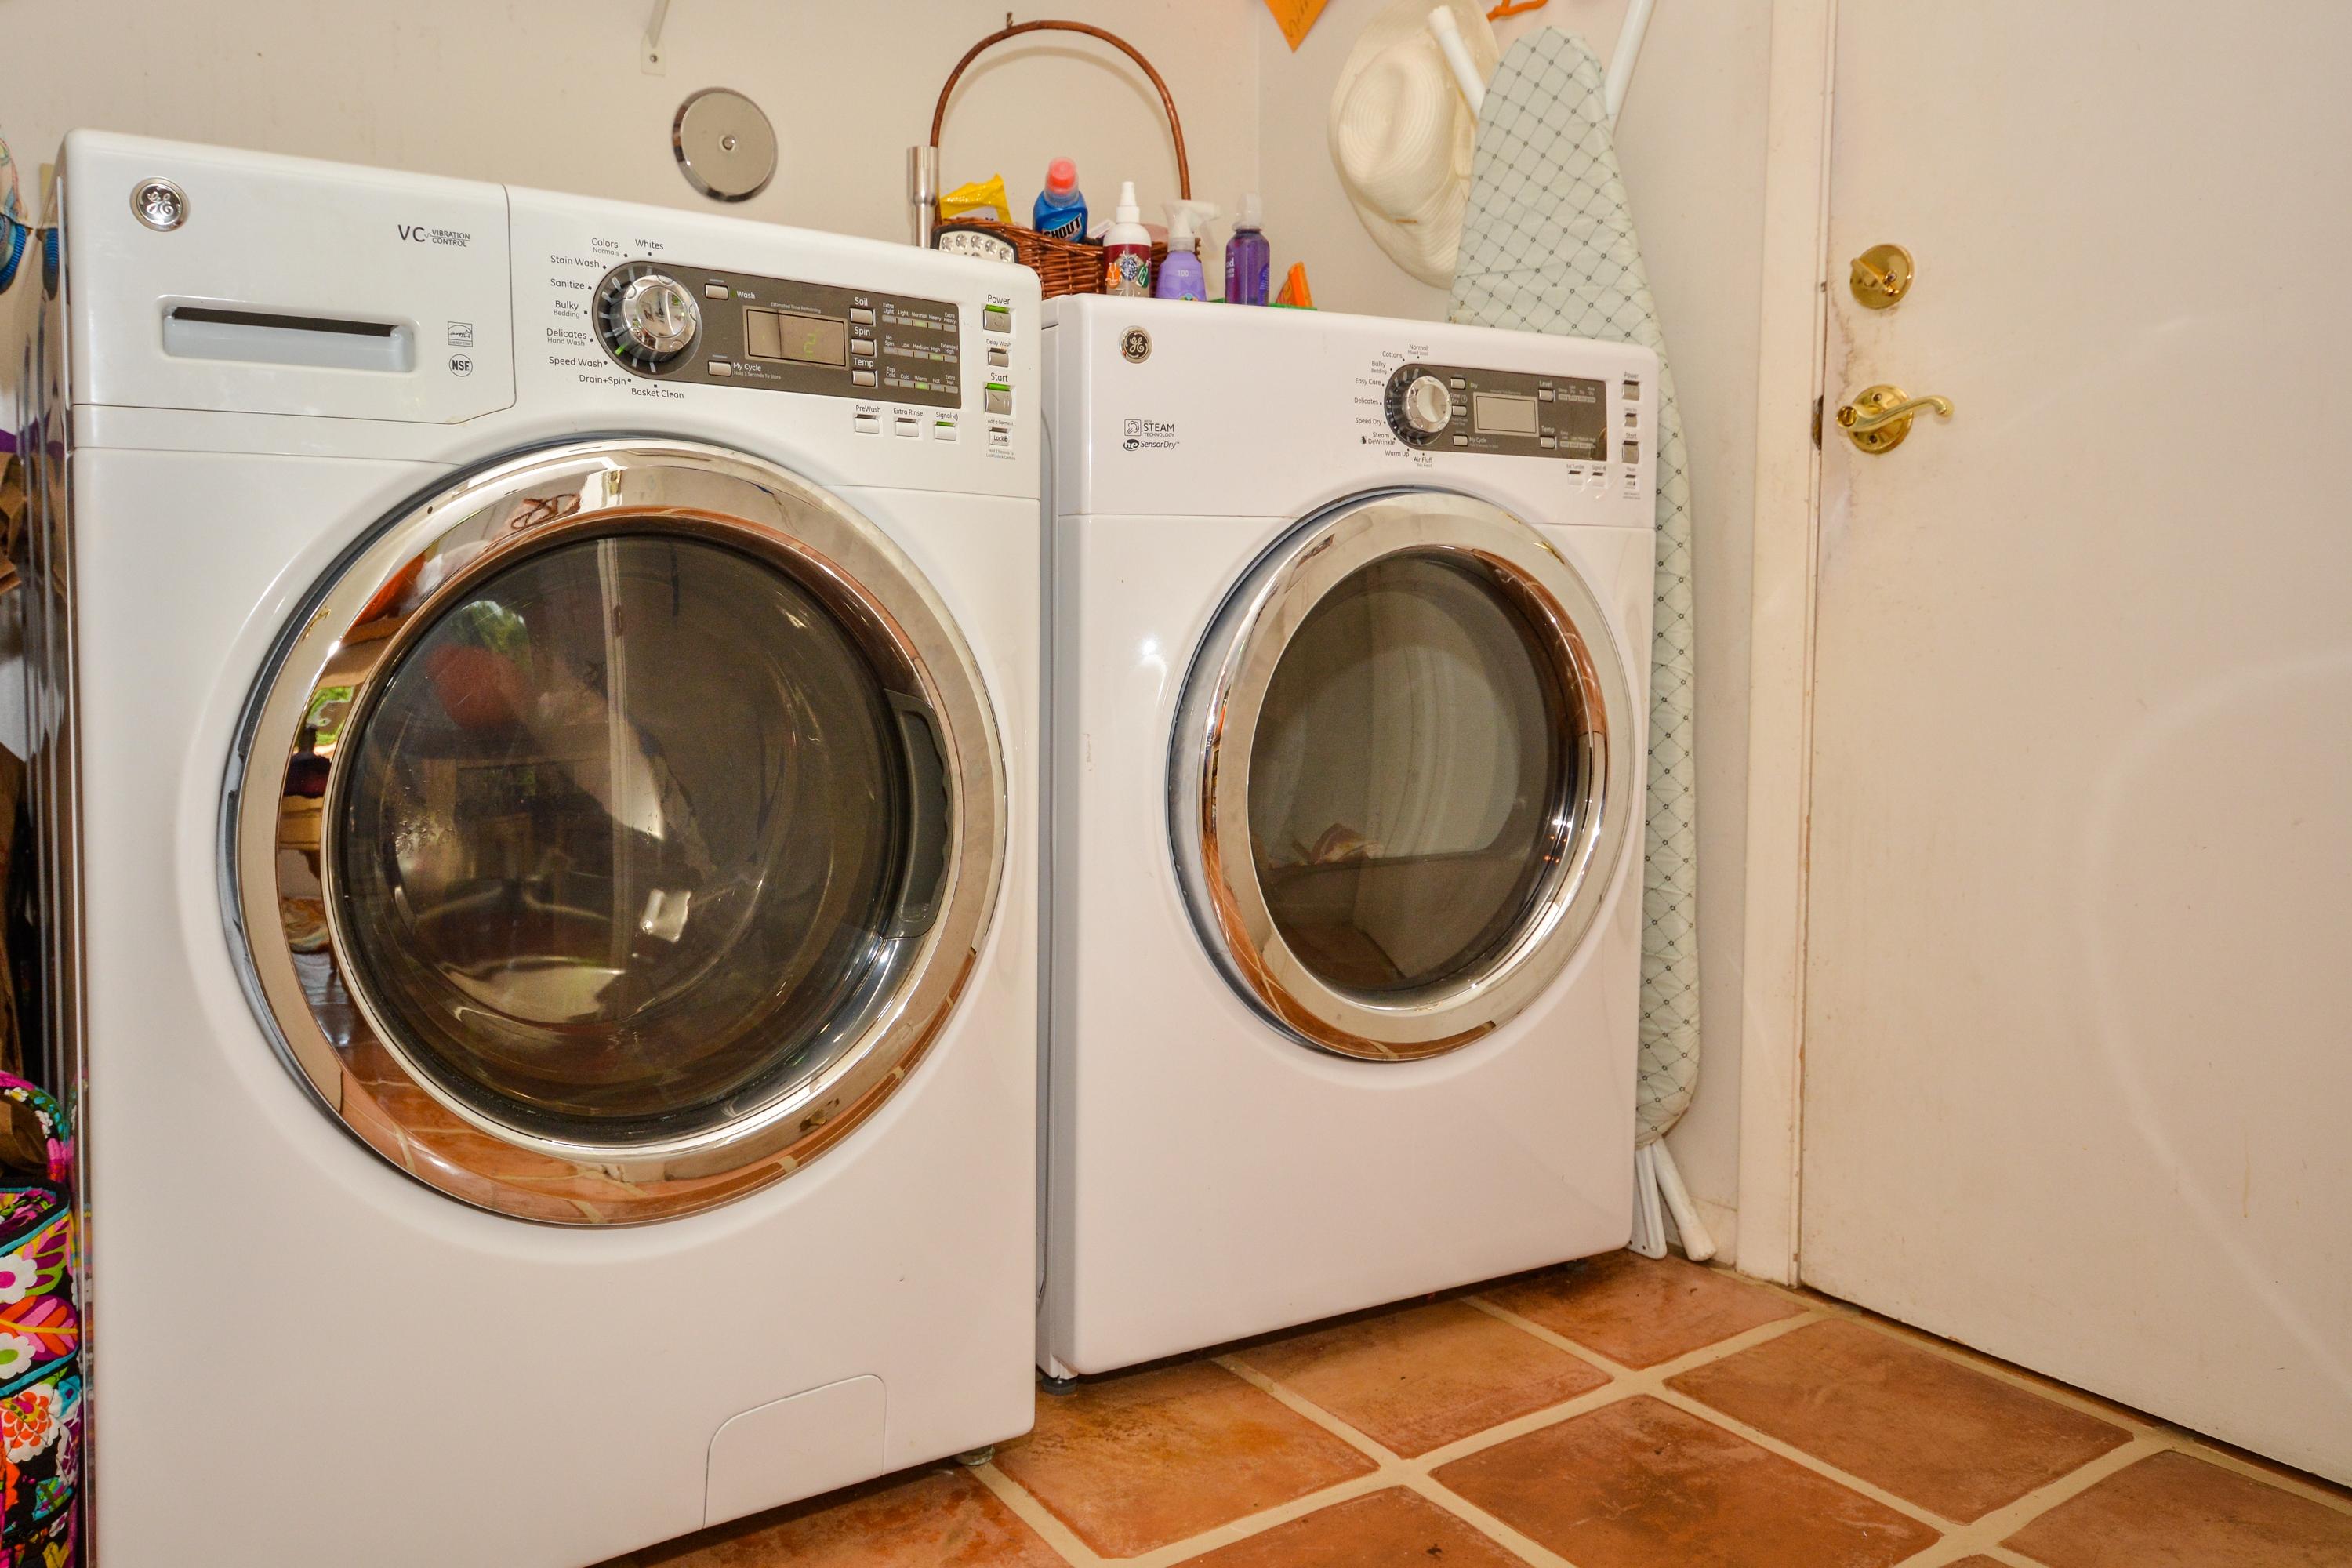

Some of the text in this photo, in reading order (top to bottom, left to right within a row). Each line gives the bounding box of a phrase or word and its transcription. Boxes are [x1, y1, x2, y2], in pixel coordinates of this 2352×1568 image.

[397, 224, 425, 242] VC
[432, 229, 470, 239] VIBRATION
[432, 238, 467, 247] CONTROL
[591, 238, 619, 249] Colors
[635, 238, 664, 250] Whites
[593, 247, 619, 256] Normals
[550, 255, 600, 268] Stain Wash
[550, 278, 585, 289] Sanitize
[737, 290, 756, 299] Wash
[987, 294, 1011, 305] Power
[555, 300, 579, 311] Bulky
[855, 296, 869, 307] Soil
[554, 310, 580, 319] Bedding
[546, 328, 587, 339] Delicates
[854, 326, 871, 336] Spin
[452, 360, 470, 371] NSF
[549, 356, 603, 368] Speed Wash
[733, 362, 761, 372] My Cycle
[853, 357, 874, 368] Temp
[579, 374, 626, 386] Drain+Spin
[990, 372, 1008, 383] Start
[631, 387, 684, 399] Basket Clean
[855, 405, 881, 413] PreWash
[936, 411, 952, 419] Signal
[1143, 423, 1174, 432] STEAM
